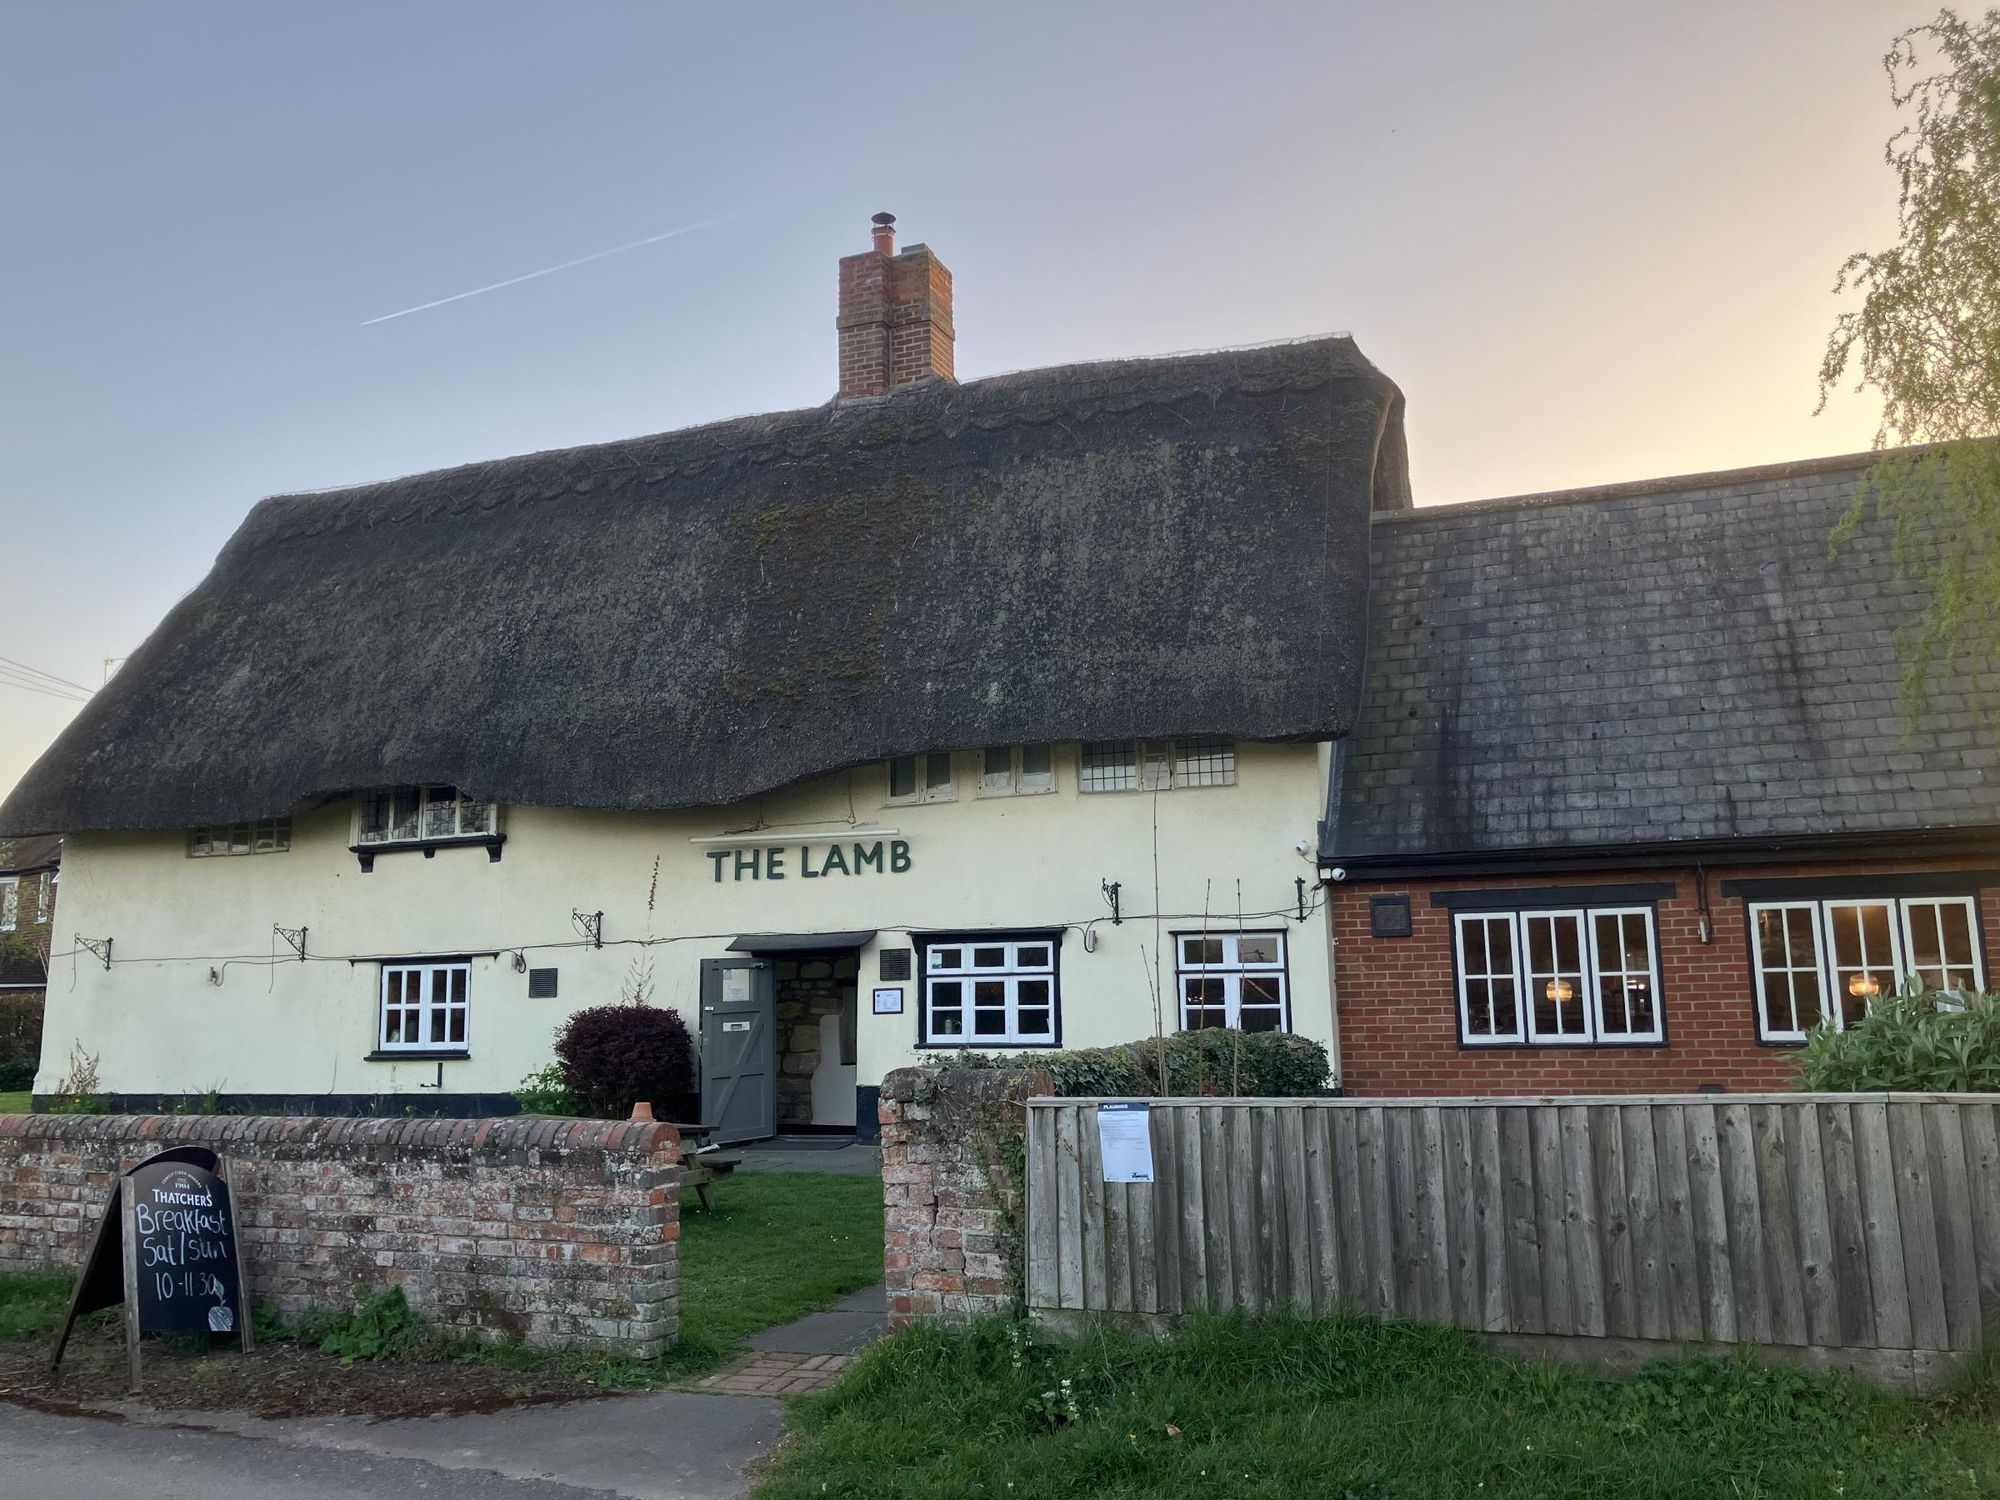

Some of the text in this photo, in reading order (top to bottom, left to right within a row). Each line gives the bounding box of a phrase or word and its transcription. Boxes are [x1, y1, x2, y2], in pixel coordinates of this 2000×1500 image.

[706, 840, 912, 883] THE LAMB
[151, 1188, 213, 1207] THATCHERS
[136, 1203, 228, 1236] Breakfast
